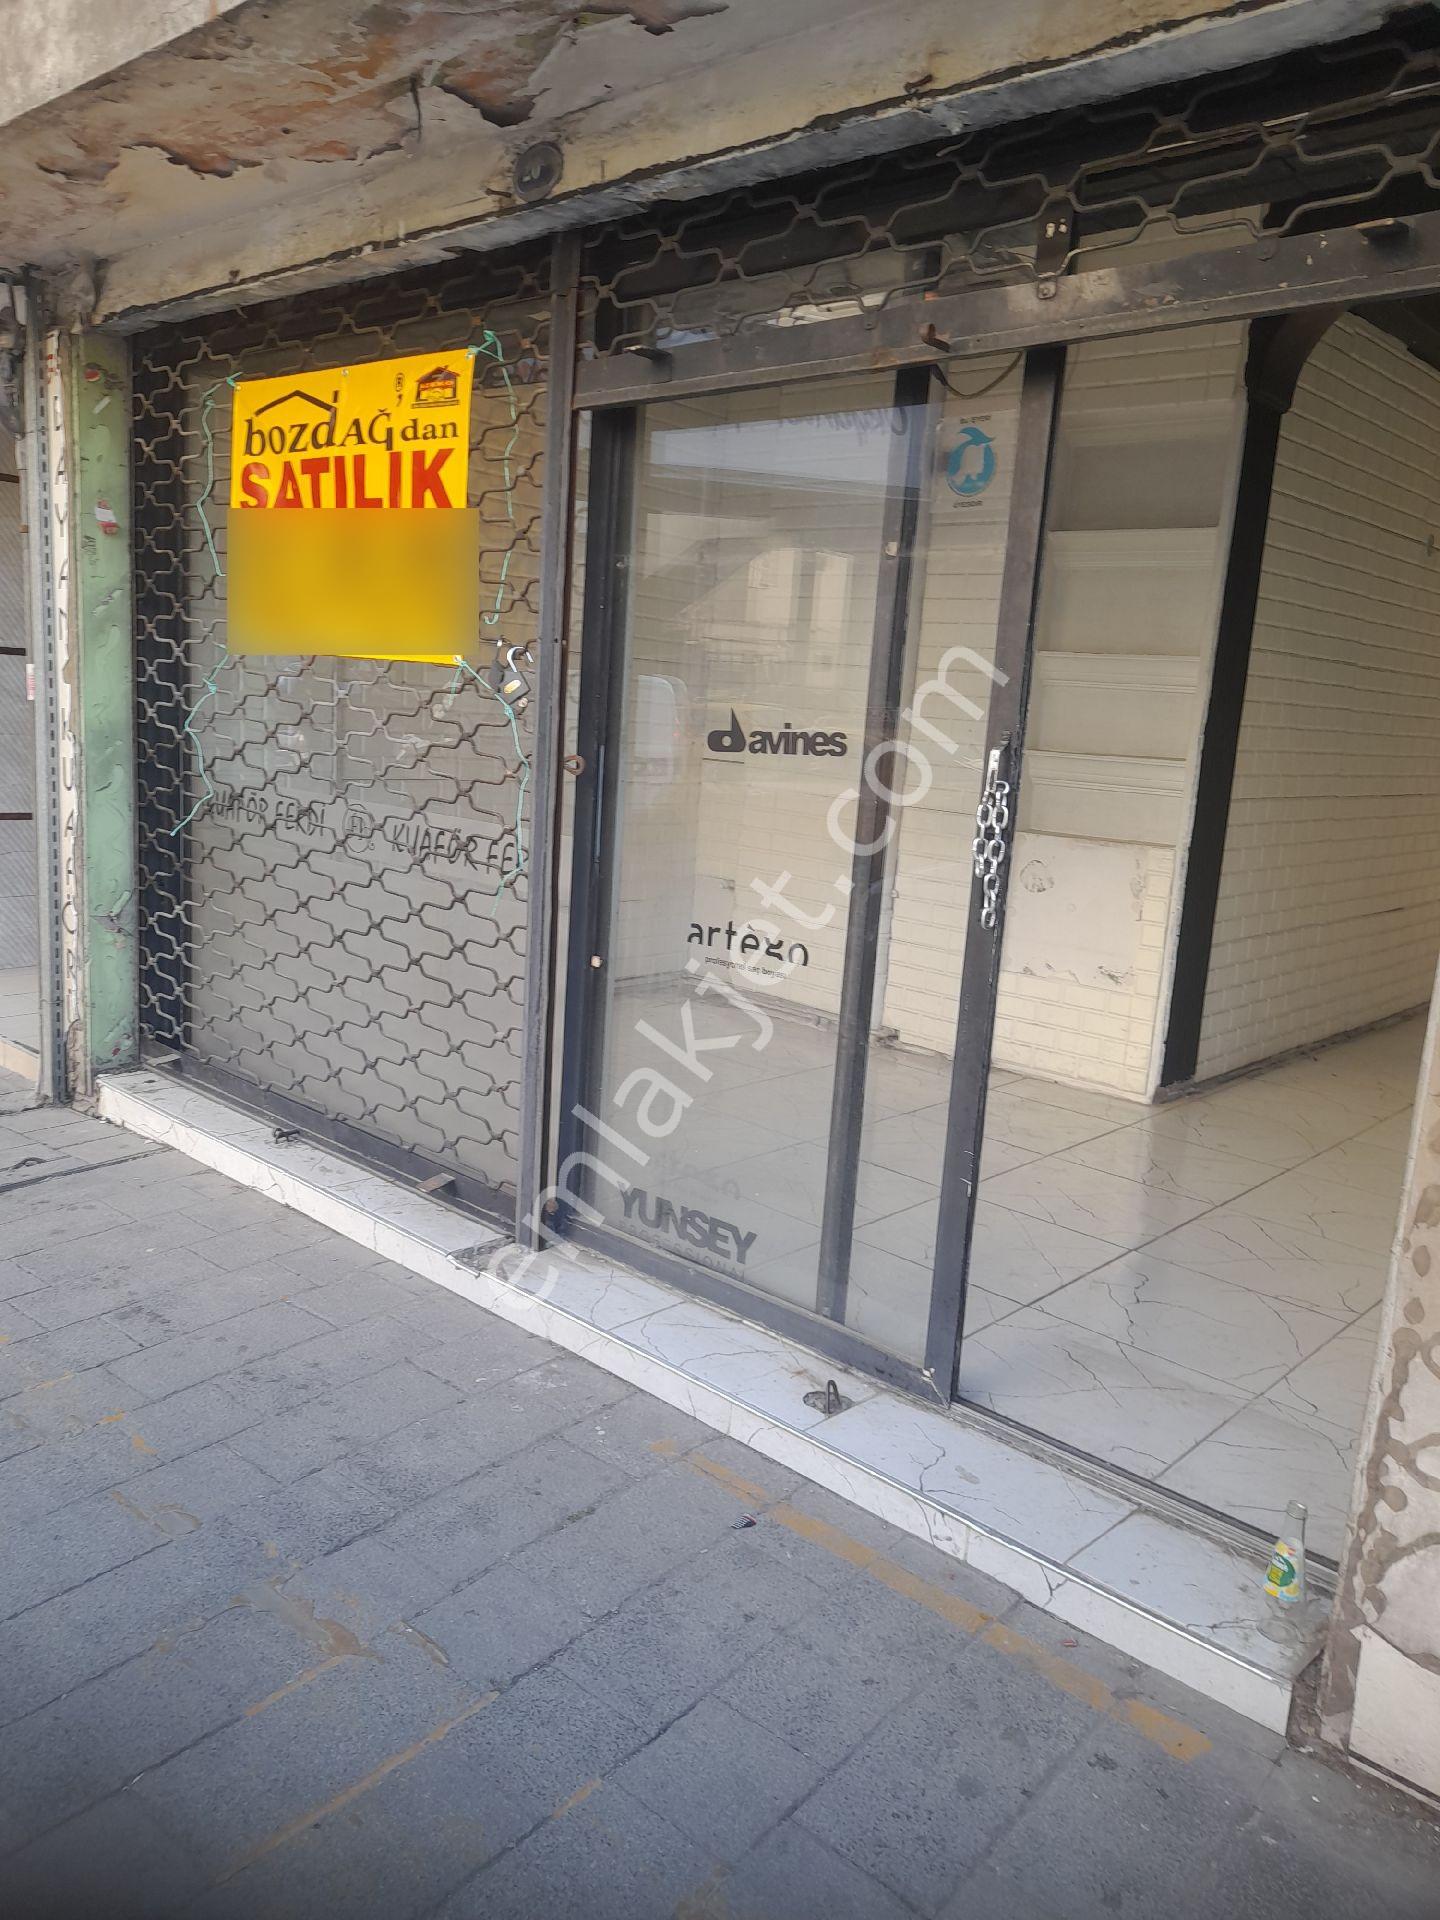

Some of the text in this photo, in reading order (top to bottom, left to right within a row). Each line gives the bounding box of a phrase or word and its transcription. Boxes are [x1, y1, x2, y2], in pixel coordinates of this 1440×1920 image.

[240, 448, 455, 508] SATILIK
[707, 706, 848, 757] davines
[617, 1181, 758, 1265] YUNSEY
